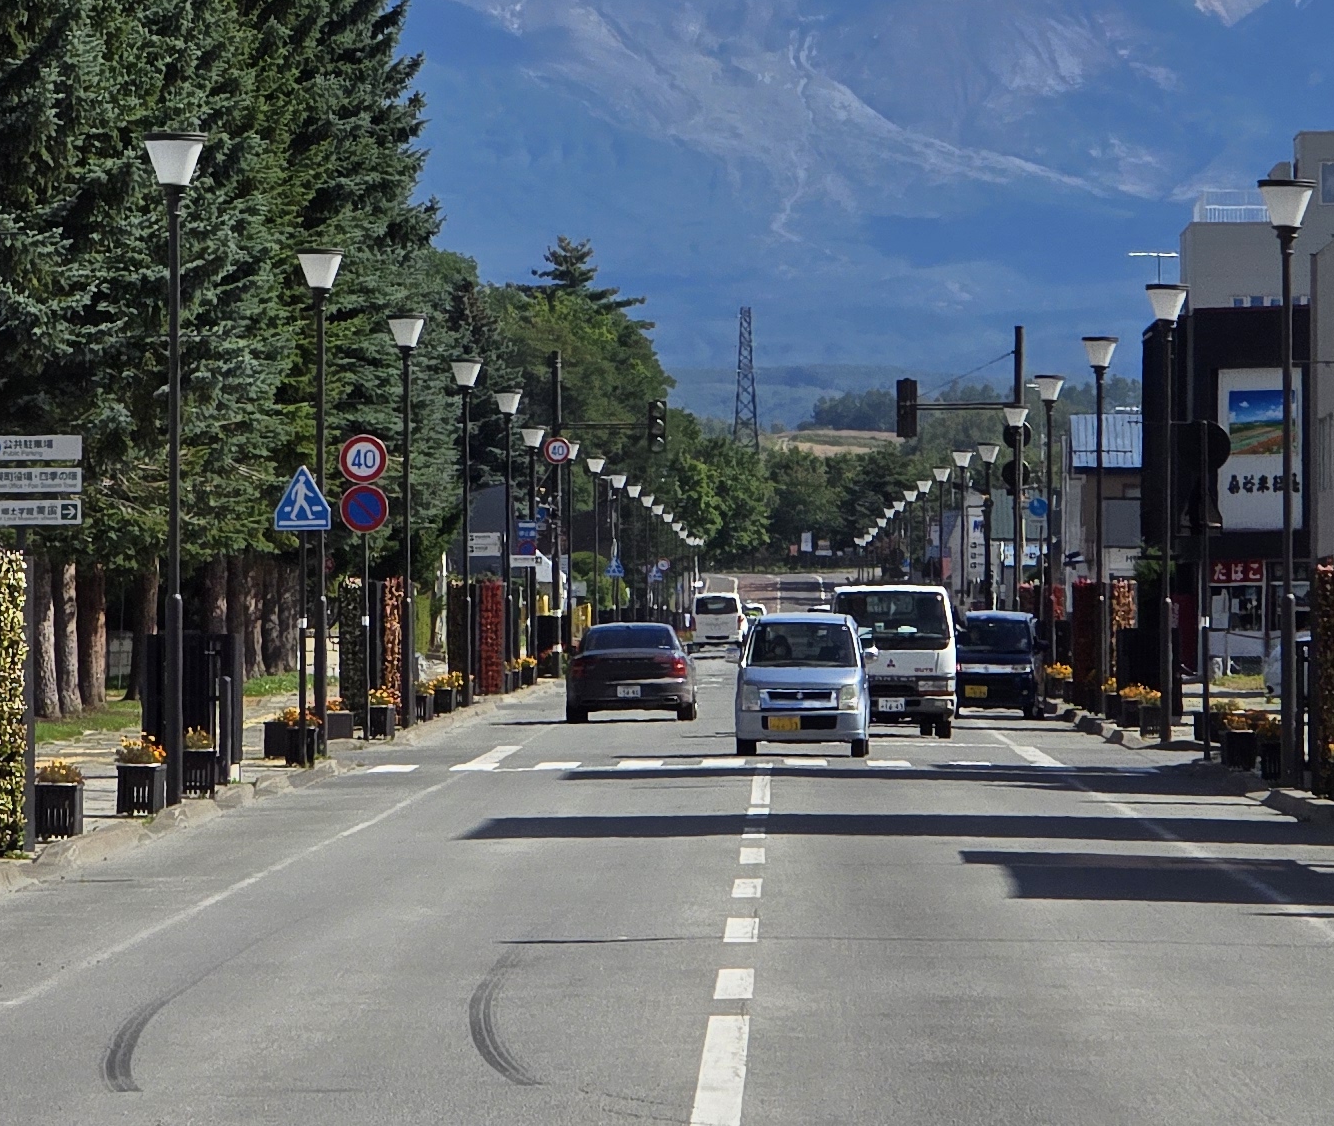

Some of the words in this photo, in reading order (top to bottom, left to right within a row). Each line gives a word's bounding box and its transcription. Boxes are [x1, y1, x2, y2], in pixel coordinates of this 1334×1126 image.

[351, 448, 376, 470] 40
[551, 444, 565, 456] 40
[1214, 563, 1261, 581] たばこ
